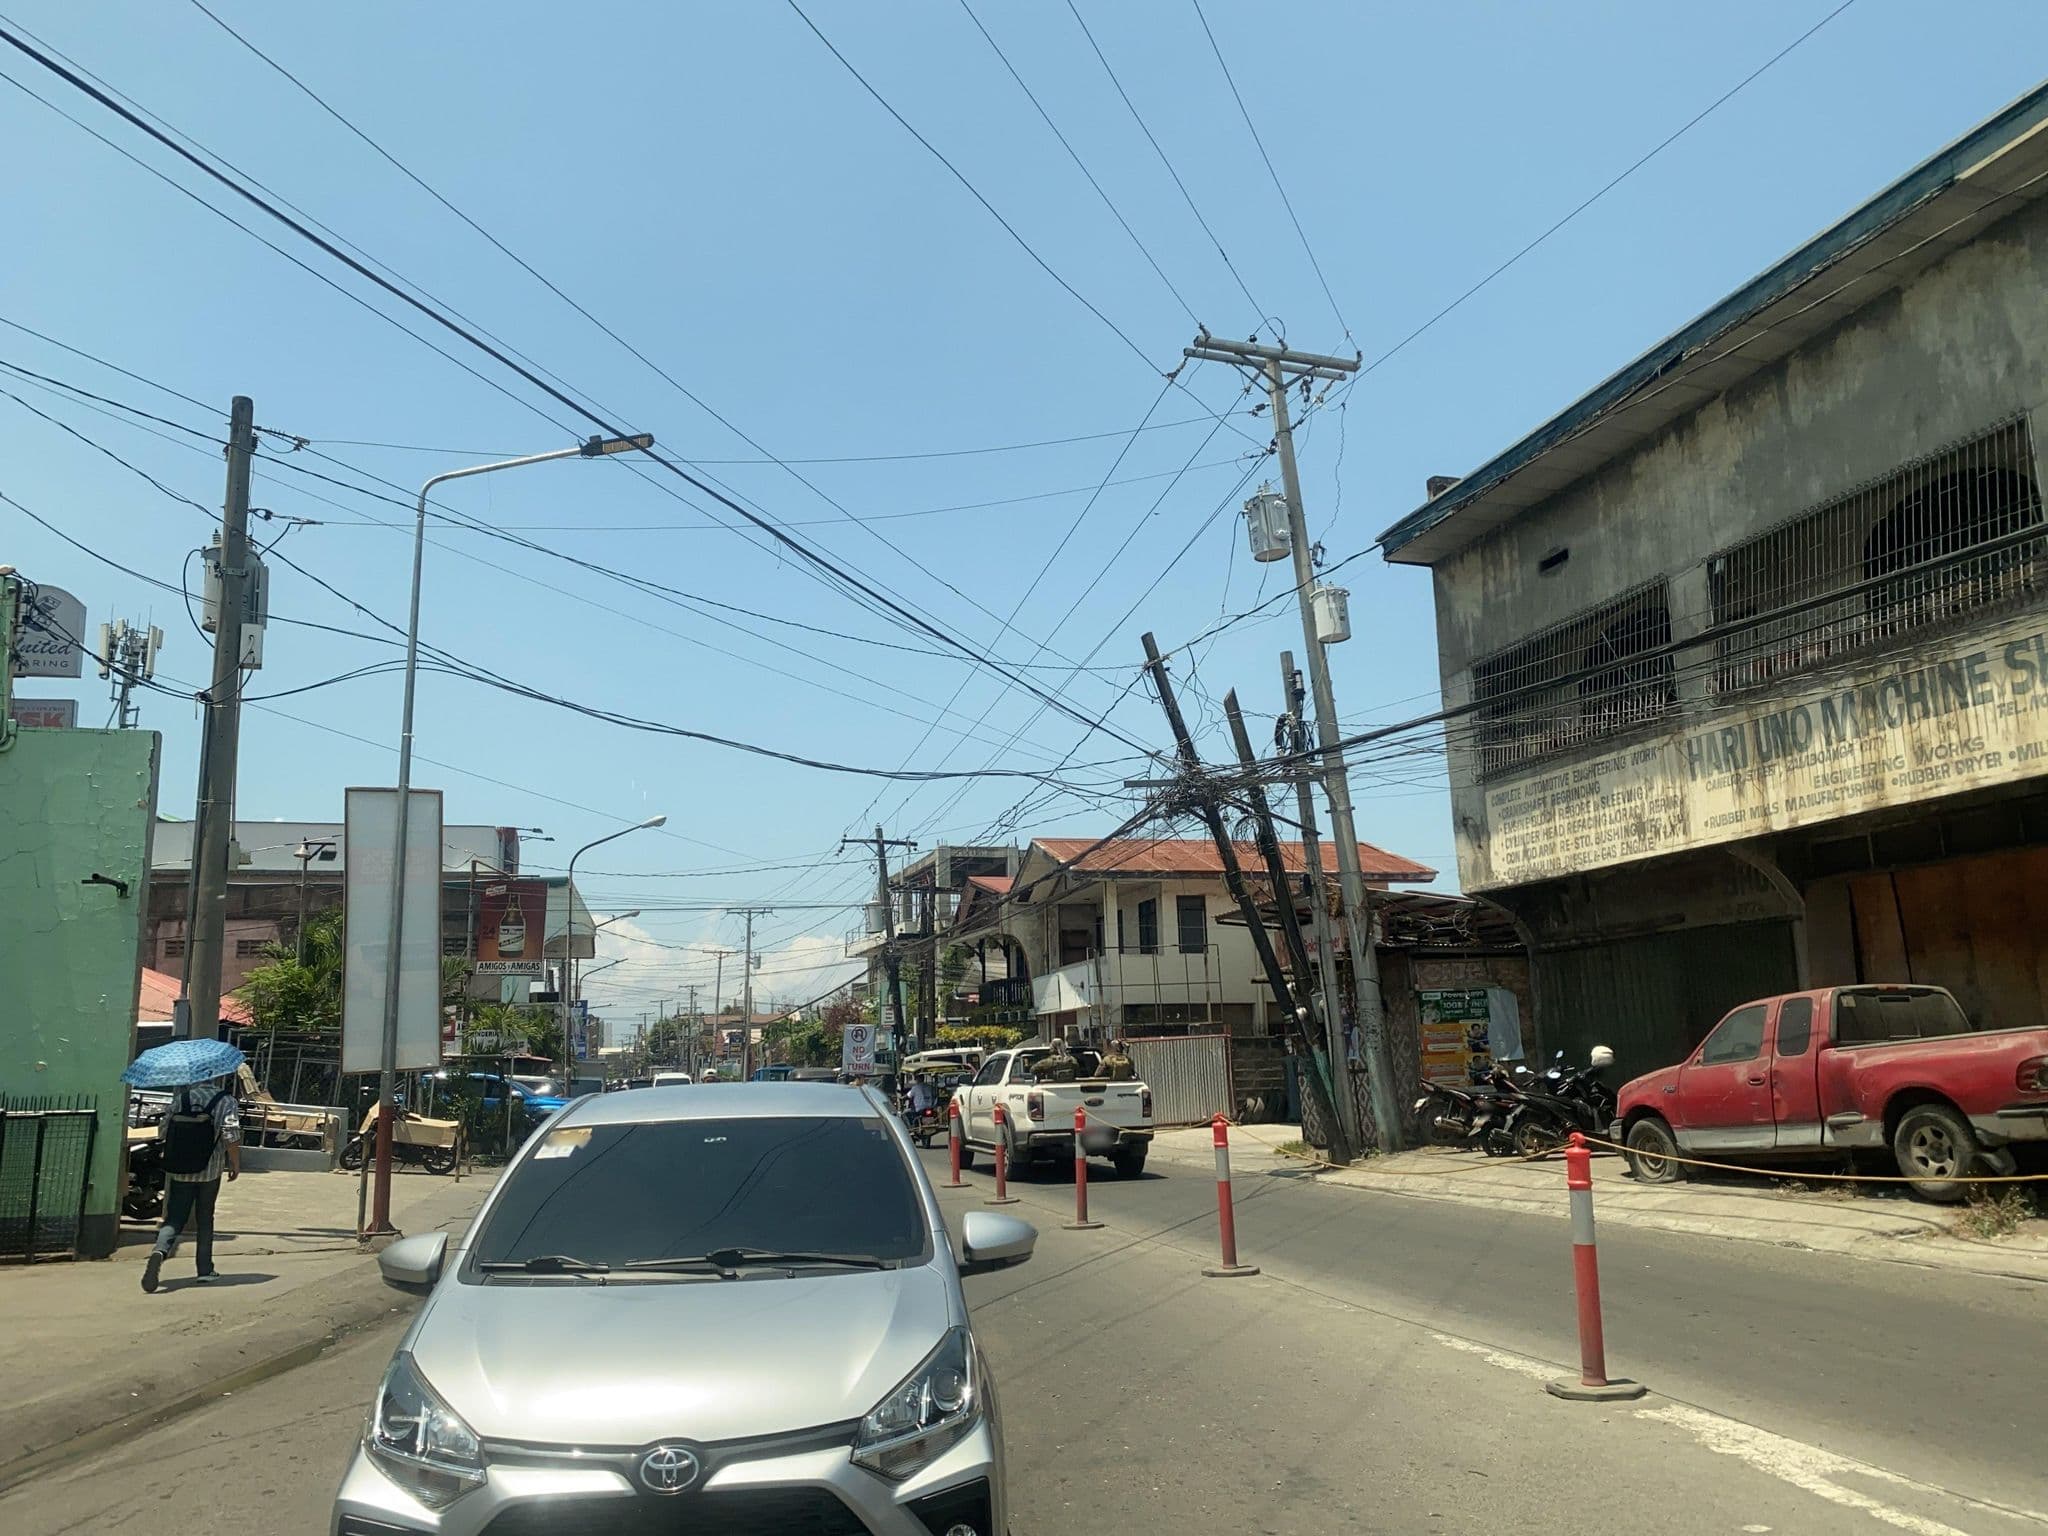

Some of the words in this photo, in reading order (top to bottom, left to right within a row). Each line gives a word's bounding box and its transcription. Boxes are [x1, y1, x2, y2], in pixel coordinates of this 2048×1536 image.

[1686, 722, 1748, 782] HARI
[1755, 706, 1813, 763] UNO
[1821, 651, 1995, 747] MACHINE
[1914, 735, 1985, 766] WORKS
[1524, 771, 1570, 801] AUTOMOTIVE
[1710, 809, 1746, 829] RUBBER
[1785, 776, 1886, 813] MANUFACTURING
[1899, 762, 1951, 788] RUBBER
[1955, 751, 2003, 775] DRYER
[478, 962, 507, 970] AMIGOS
[510, 961, 540, 971] AMIGAS
[852, 1046, 865, 1054] NO
[847, 1062, 870, 1071] TURN
